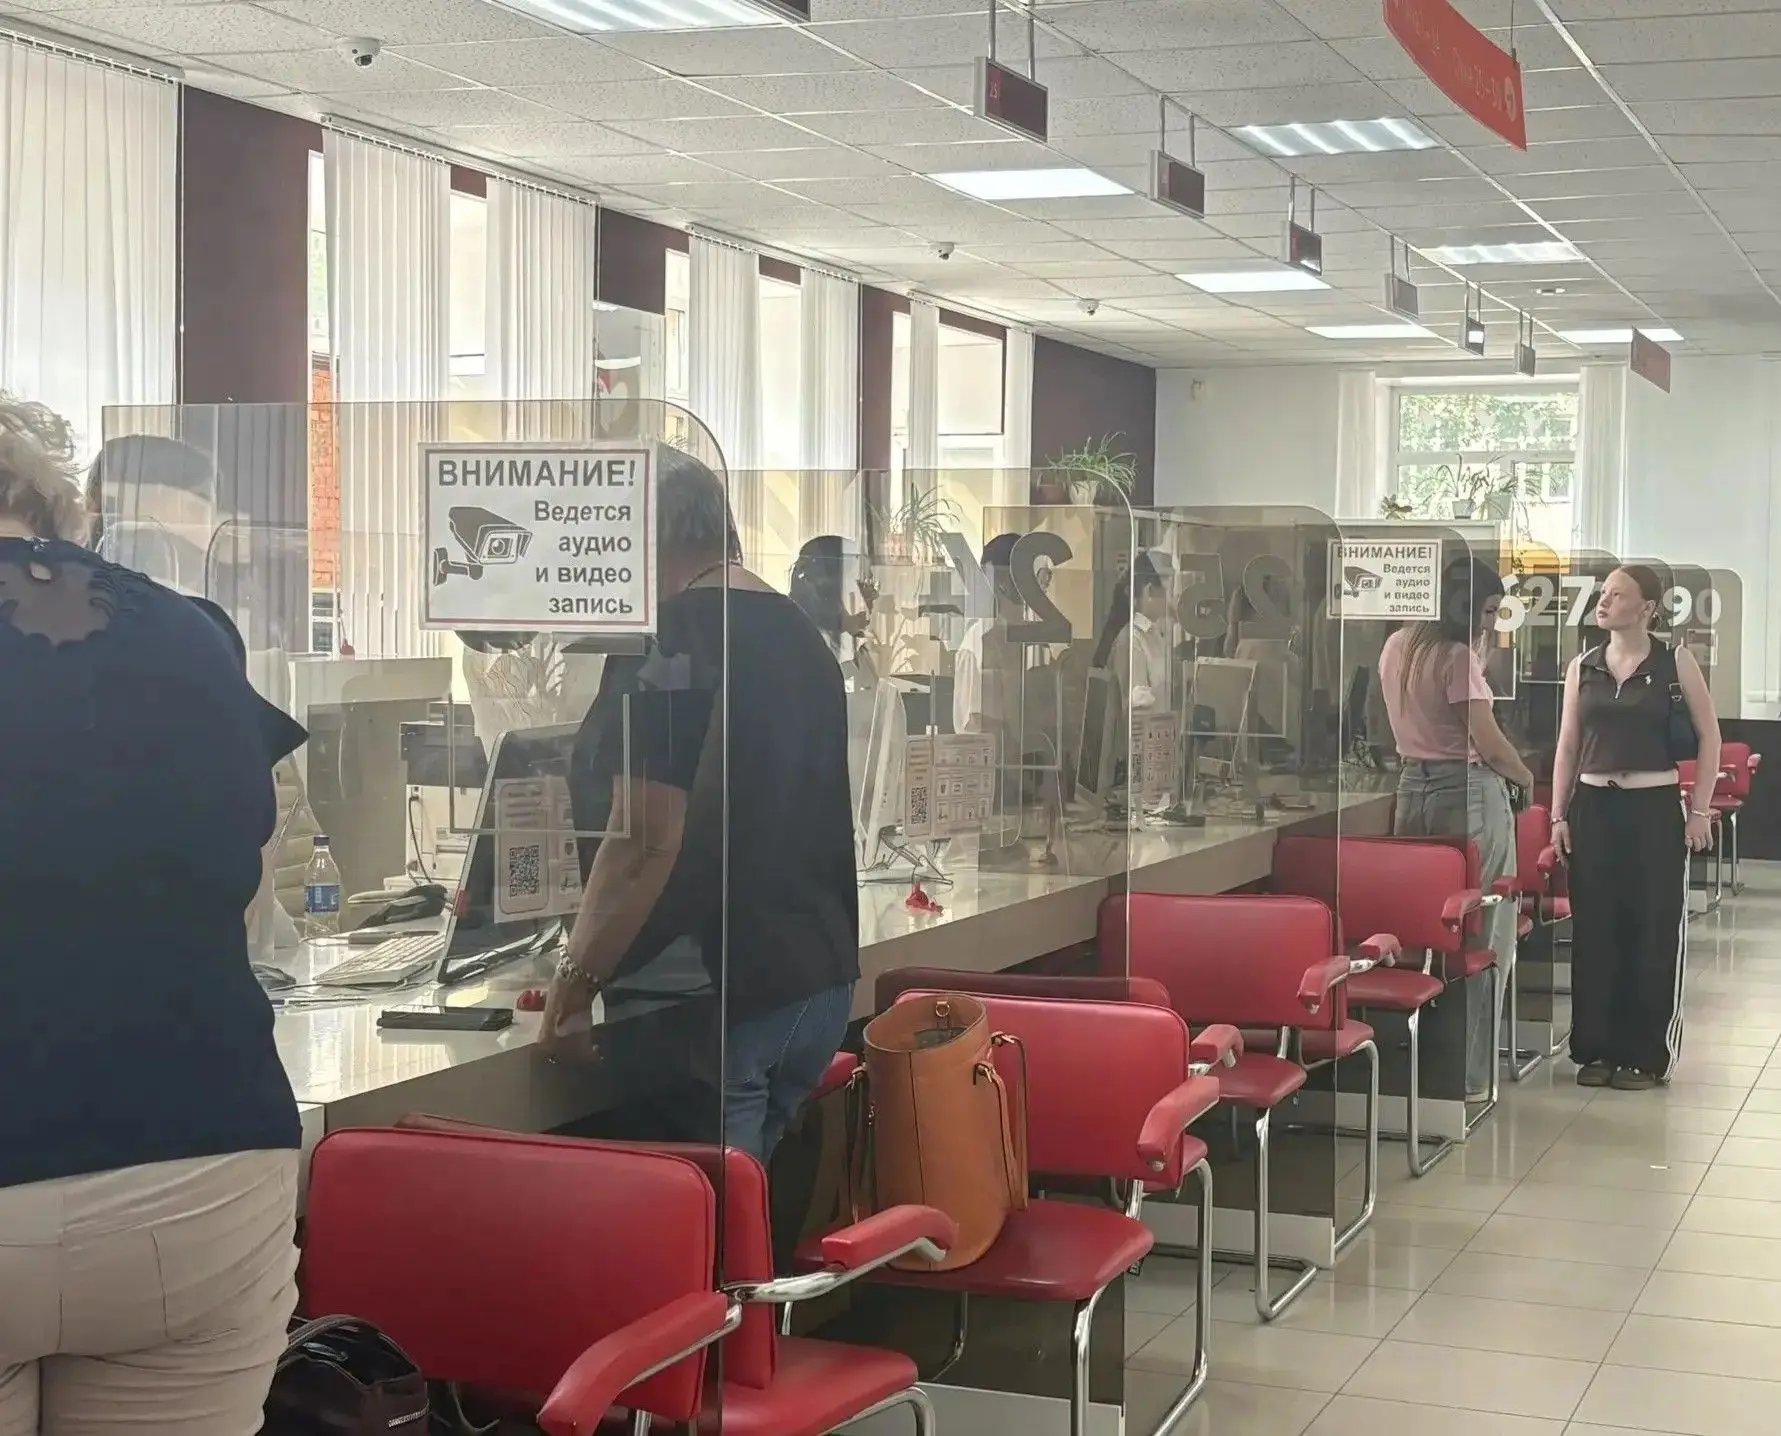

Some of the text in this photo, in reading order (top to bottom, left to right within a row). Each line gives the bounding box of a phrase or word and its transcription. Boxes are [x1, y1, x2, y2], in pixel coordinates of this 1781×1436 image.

[438, 459, 636, 488] ВНИМАНИЕ!
[534, 500, 632, 525] Ведется
[558, 535, 632, 557] аудио
[1337, 546, 1432, 559] ВНИМАНИЕ!
[536, 567, 632, 586] и видео
[1383, 564, 1431, 574] Ведется
[1395, 578, 1431, 588] аудио
[548, 597, 633, 615] запись
[1394, 592, 1430, 601] видео
[1523, 575, 1596, 627] 27
[1662, 585, 1693, 627] 9
[1389, 604, 1430, 613] запись
[1695, 588, 1722, 626] 0
